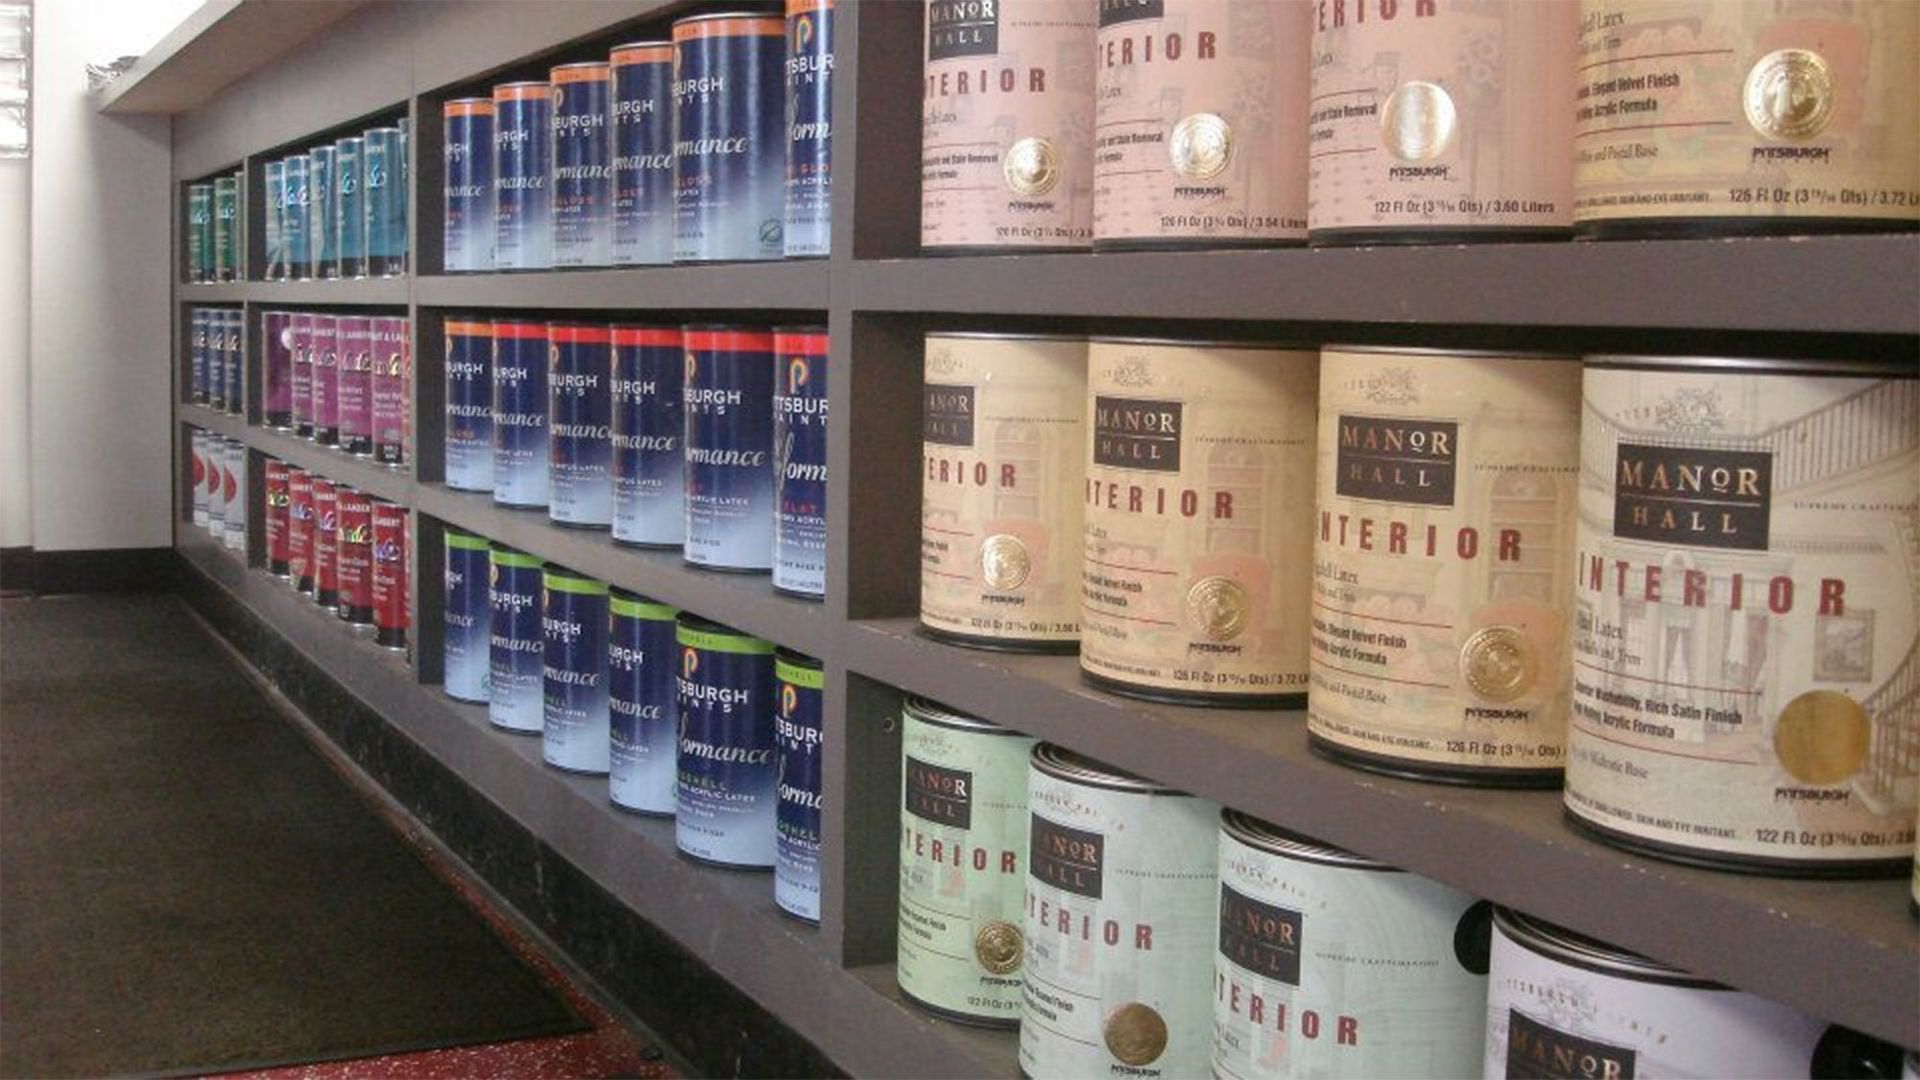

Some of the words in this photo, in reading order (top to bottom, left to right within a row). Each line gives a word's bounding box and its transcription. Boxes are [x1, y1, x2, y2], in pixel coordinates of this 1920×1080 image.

[1342, 425, 1450, 455] MANOR
[1350, 463, 1431, 487] HALL
[1621, 459, 1761, 496] MANOR
[1632, 505, 1737, 535] HALL
[1579, 551, 1846, 617] INTERIOR
